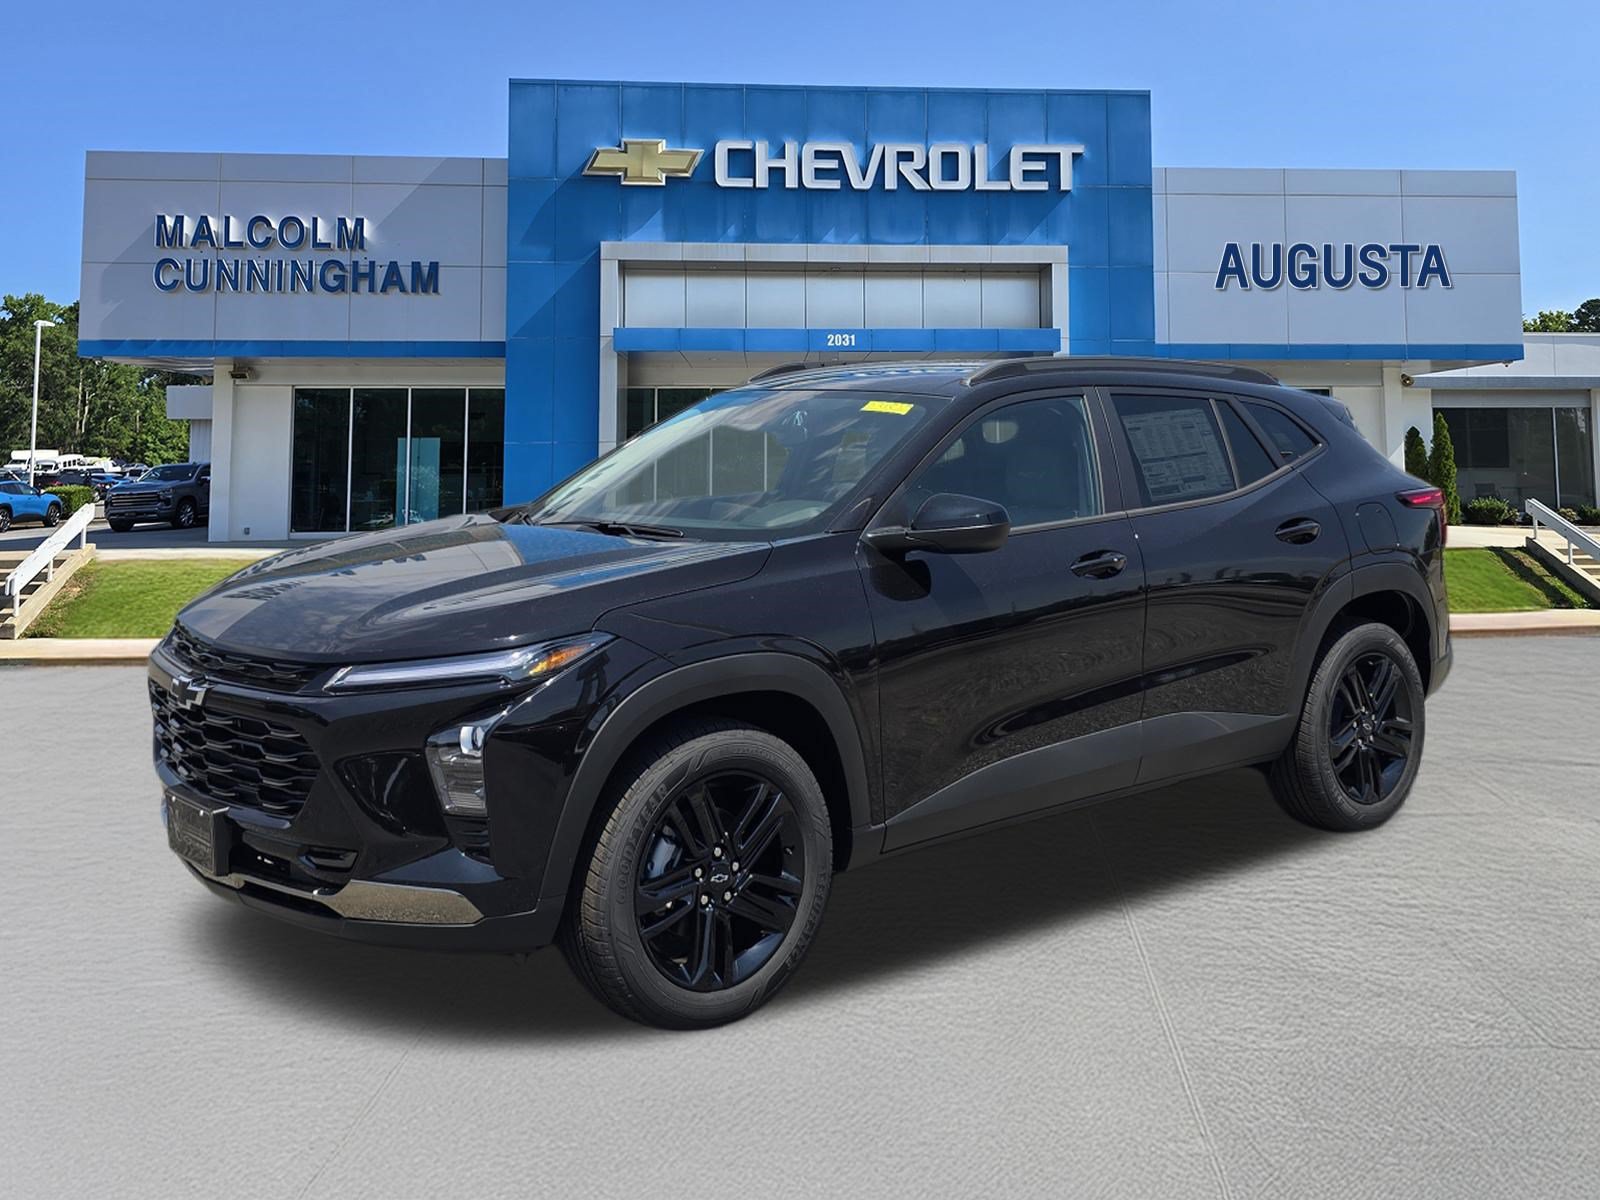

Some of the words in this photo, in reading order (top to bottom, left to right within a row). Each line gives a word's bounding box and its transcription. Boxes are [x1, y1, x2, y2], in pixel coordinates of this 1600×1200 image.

[714, 139, 1084, 192] CHEVROLET
[153, 213, 368, 250] MALCOLM
[152, 256, 441, 294] CUNNINGHAM
[1214, 241, 1452, 290] AUGUSTA
[826, 334, 857, 347] 2031
[615, 783, 668, 904] GOODYEAR
